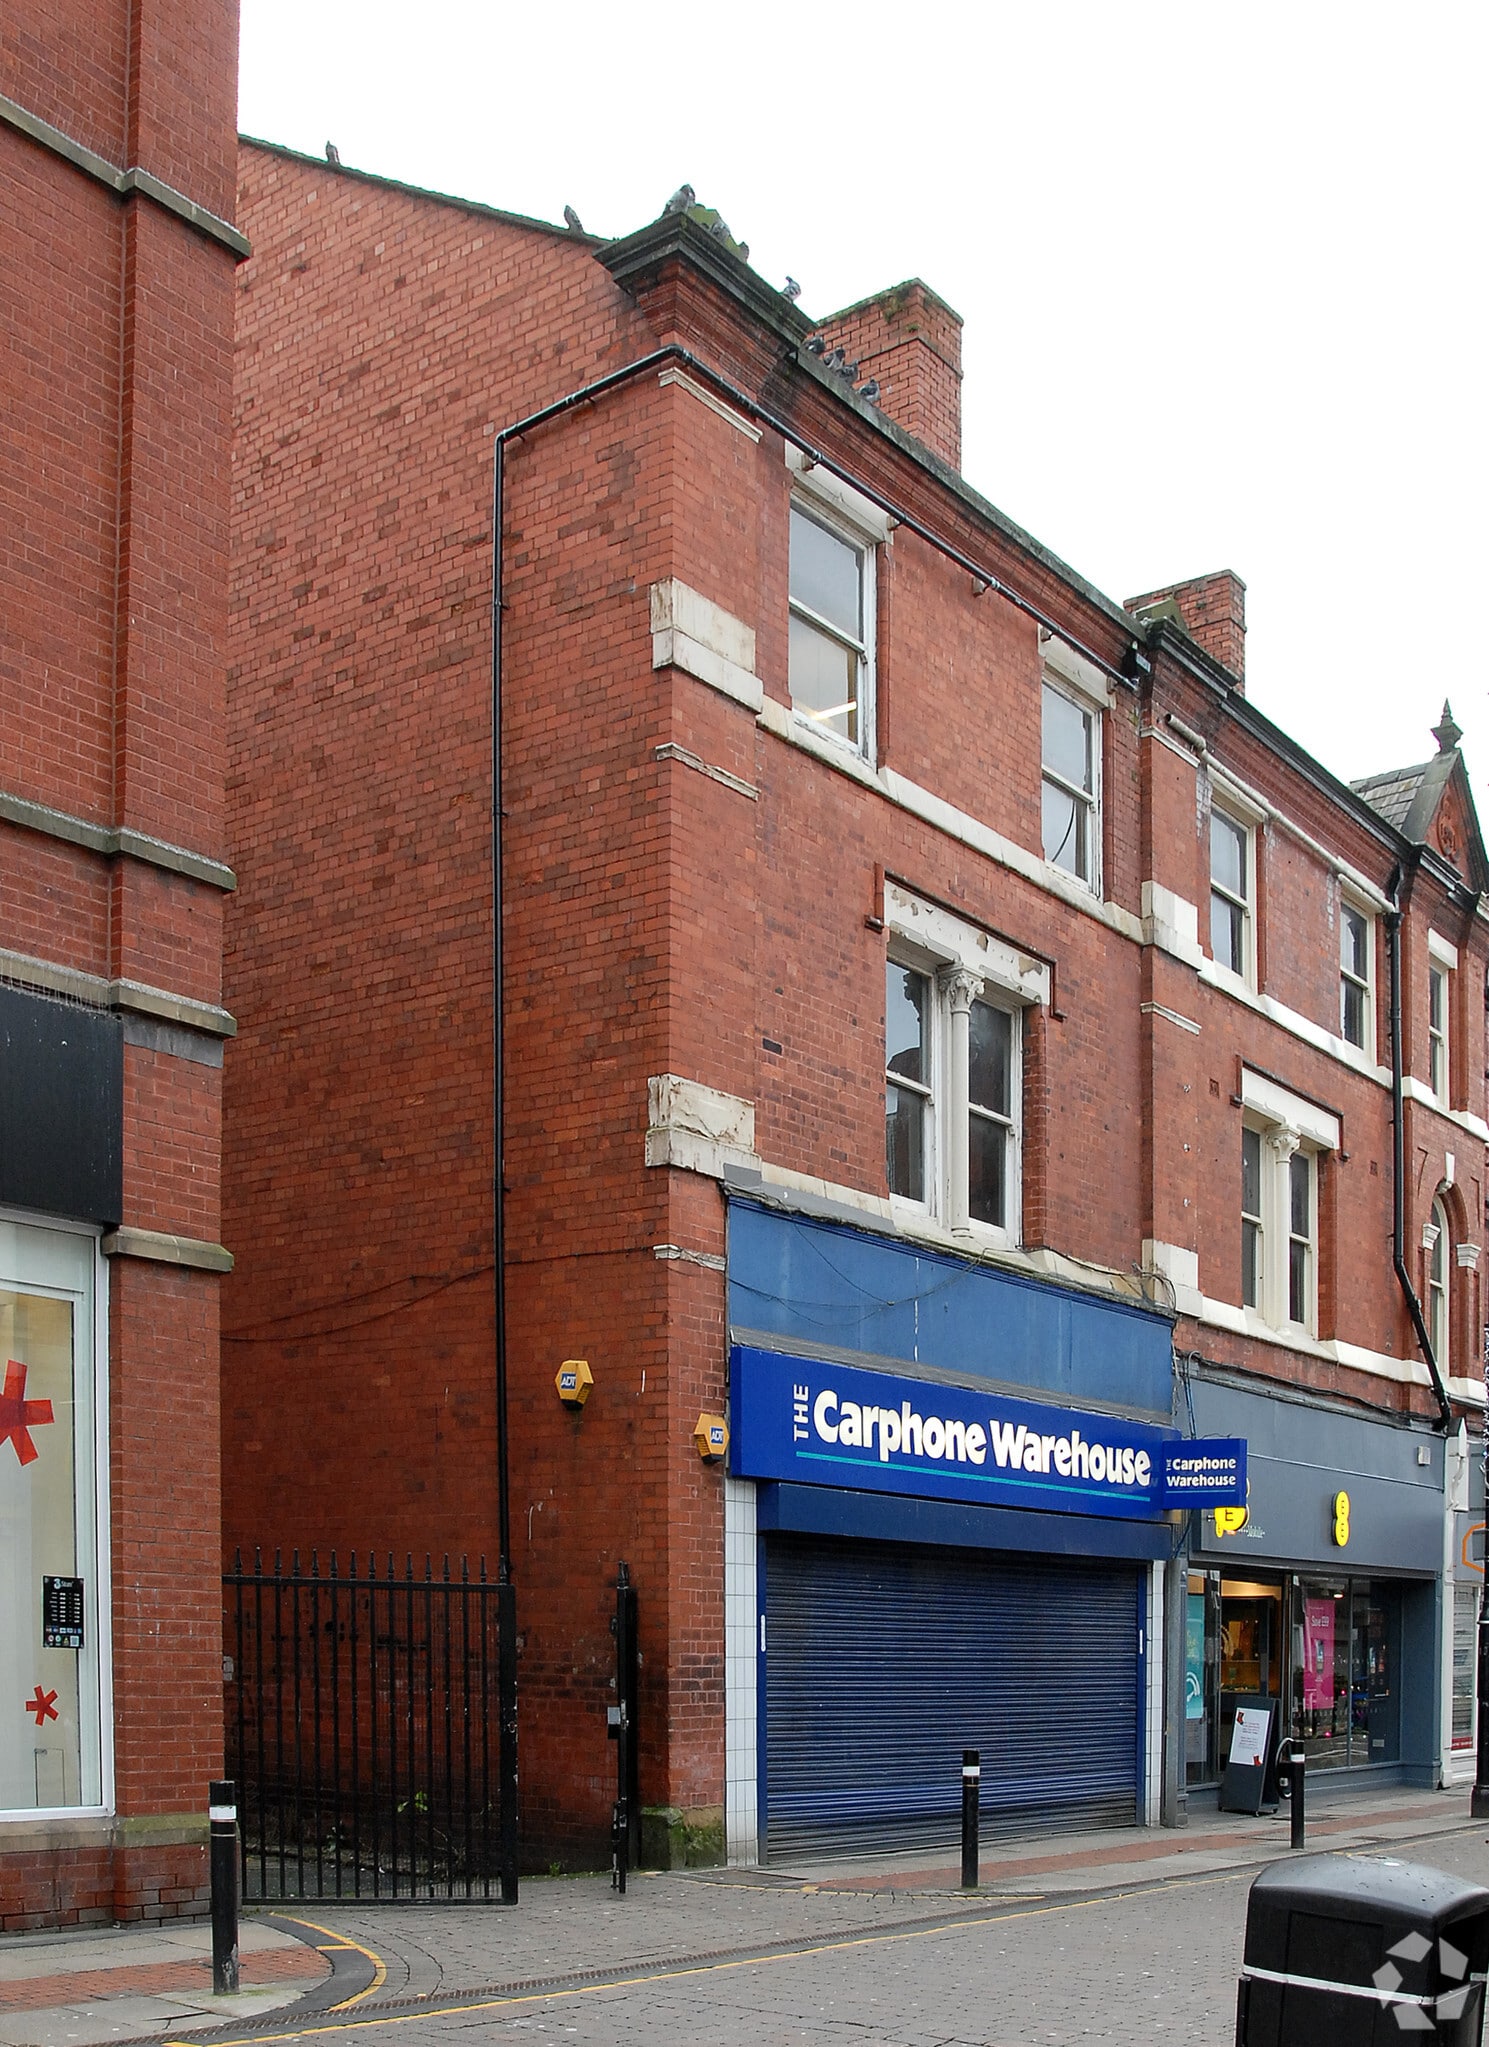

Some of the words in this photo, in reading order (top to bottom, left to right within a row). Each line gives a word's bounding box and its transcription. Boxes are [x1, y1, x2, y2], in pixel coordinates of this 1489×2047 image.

[561, 1375, 576, 1387] ADT
[793, 1384, 809, 1441] THE
[813, 1389, 987, 1465] Carphone
[989, 1420, 1151, 1487] Warehouse
[1172, 1457, 1236, 1472] Carphone
[1166, 1474, 1236, 1487] Warehouse
